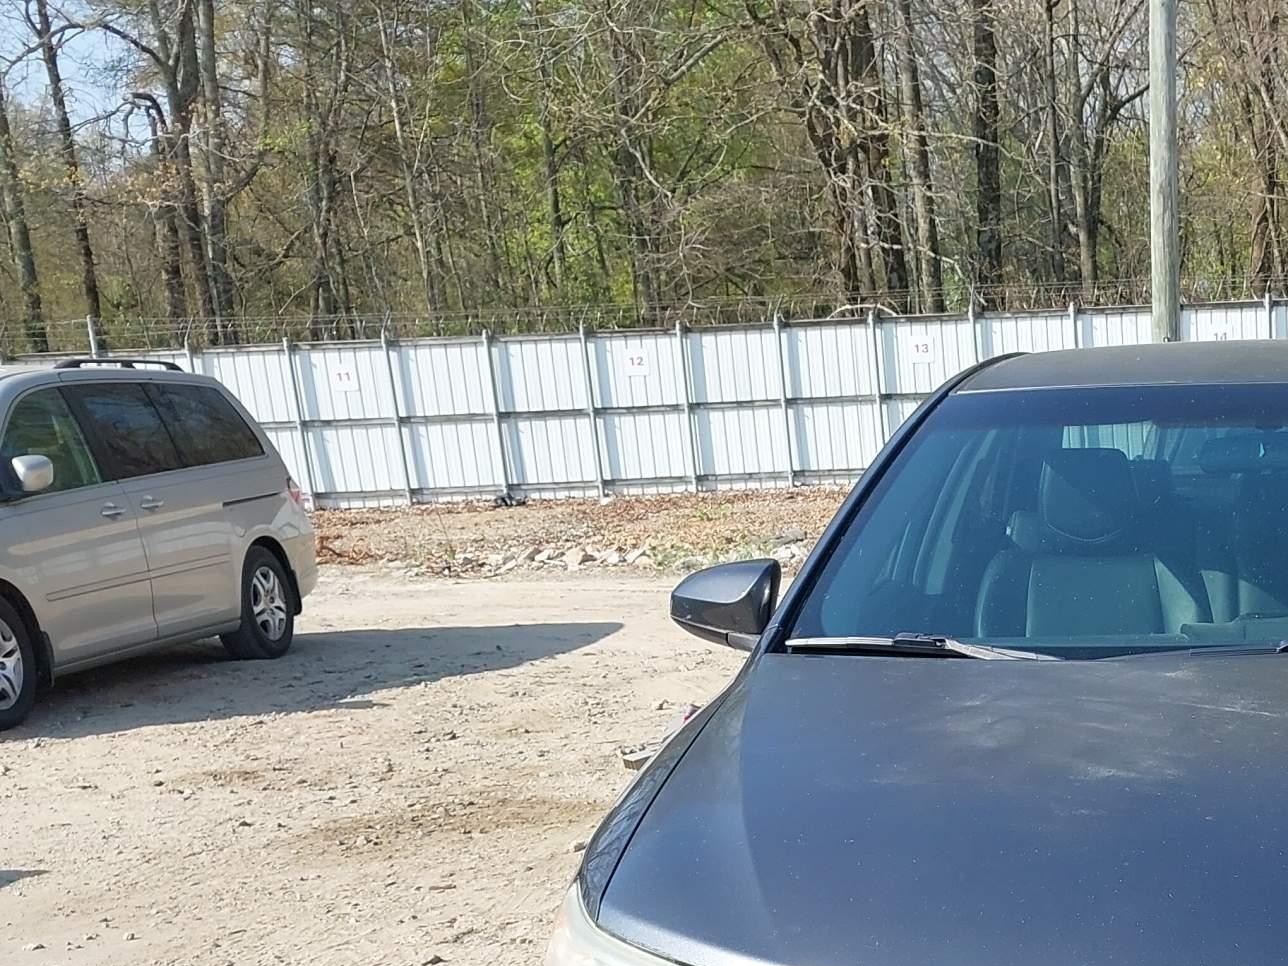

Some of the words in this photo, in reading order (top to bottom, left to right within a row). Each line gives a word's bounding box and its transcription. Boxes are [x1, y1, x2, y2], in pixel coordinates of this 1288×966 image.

[914, 343, 929, 353] 13
[629, 356, 645, 366] 12
[336, 372, 350, 381] 11
